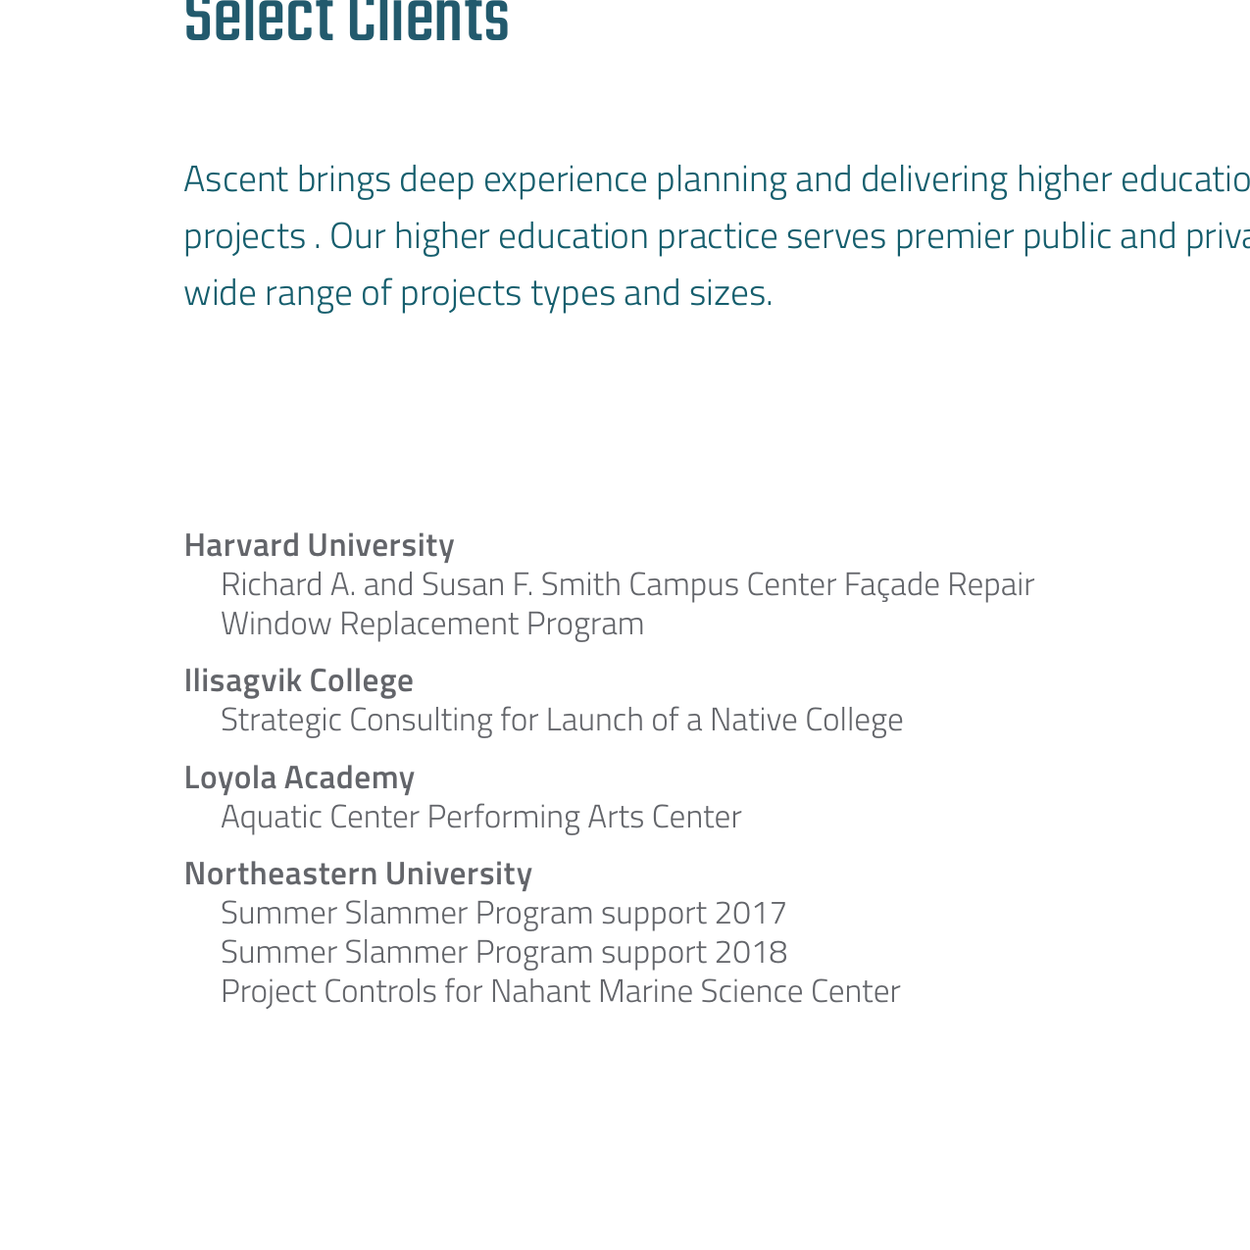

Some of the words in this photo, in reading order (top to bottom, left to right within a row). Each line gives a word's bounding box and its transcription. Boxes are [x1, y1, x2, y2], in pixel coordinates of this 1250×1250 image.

[183, 164, 289, 193] Ascent
[298, 163, 391, 201] brings
[400, 163, 475, 201] deep
[484, 164, 647, 201] experience
[657, 163, 788, 201] planning
[795, 163, 851, 193] and
[861, 163, 1009, 201] delivering
[1018, 163, 1113, 201] higher
[185, 221, 306, 258] projects
[330, 221, 387, 250] Our
[396, 220, 491, 258] higher
[499, 220, 648, 250] education
[658, 221, 778, 258] practice
[787, 228, 886, 250] serves
[897, 221, 1015, 258] premier
[1024, 220, 1112, 258] public
[1120, 220, 1176, 250] and
[183, 277, 256, 307] wide
[266, 285, 352, 315] range
[361, 277, 394, 307] of
[401, 278, 522, 315] projects
[530, 279, 616, 315] types
[624, 277, 680, 307] and
[690, 278, 772, 307] sizes.
[185, 531, 299, 558] Harvard
[308, 532, 455, 564] University
[222, 570, 322, 597] Richard
[330, 571, 355, 596] A.
[364, 570, 413, 597] and
[422, 571, 504, 597] Susan
[514, 571, 533, 596] F.
[541, 570, 621, 597] Smith
[629, 571, 739, 604] Campus
[747, 571, 838, 597] Center
[845, 570, 940, 603] Façade
[949, 571, 1036, 604] Repair
[220, 610, 332, 636] Window
[341, 610, 520, 643] Replacement
[528, 610, 644, 643] Program
[185, 667, 303, 700] Ilisagvik
[310, 667, 414, 700] College
[221, 706, 342, 739] Strategic
[350, 706, 493, 739] Consulting
[500, 705, 539, 732] for
[547, 706, 643, 732] Launch
[652, 705, 680, 732] of
[686, 713, 703, 732] a
[711, 706, 797, 732] Native
[806, 706, 903, 739] College
[185, 764, 277, 796] Loyola
[283, 764, 415, 796] Academy
[220, 803, 323, 836] Aquatic
[330, 803, 421, 829] Center
[428, 802, 581, 836] Performing
[587, 804, 644, 829] Arts
[653, 803, 743, 829] Center
[185, 860, 377, 886] Northeastern
[386, 860, 533, 893] University
[221, 899, 338, 925] Summer
[345, 899, 469, 925] Slammer
[477, 900, 593, 933] Program
[601, 901, 708, 932] support
[715, 900, 786, 925] 2017
[221, 938, 338, 964] Summer
[345, 938, 469, 964] Slammer
[477, 939, 593, 972] Program
[601, 940, 708, 972] support
[715, 940, 787, 964] 2018
[222, 978, 317, 1010] Project
[324, 977, 437, 1004] Controls
[444, 977, 484, 1004] for
[492, 977, 592, 1004] Nahant
[600, 978, 693, 1004] Marine
[701, 978, 803, 1004] Science
[812, 978, 902, 1004] Center
